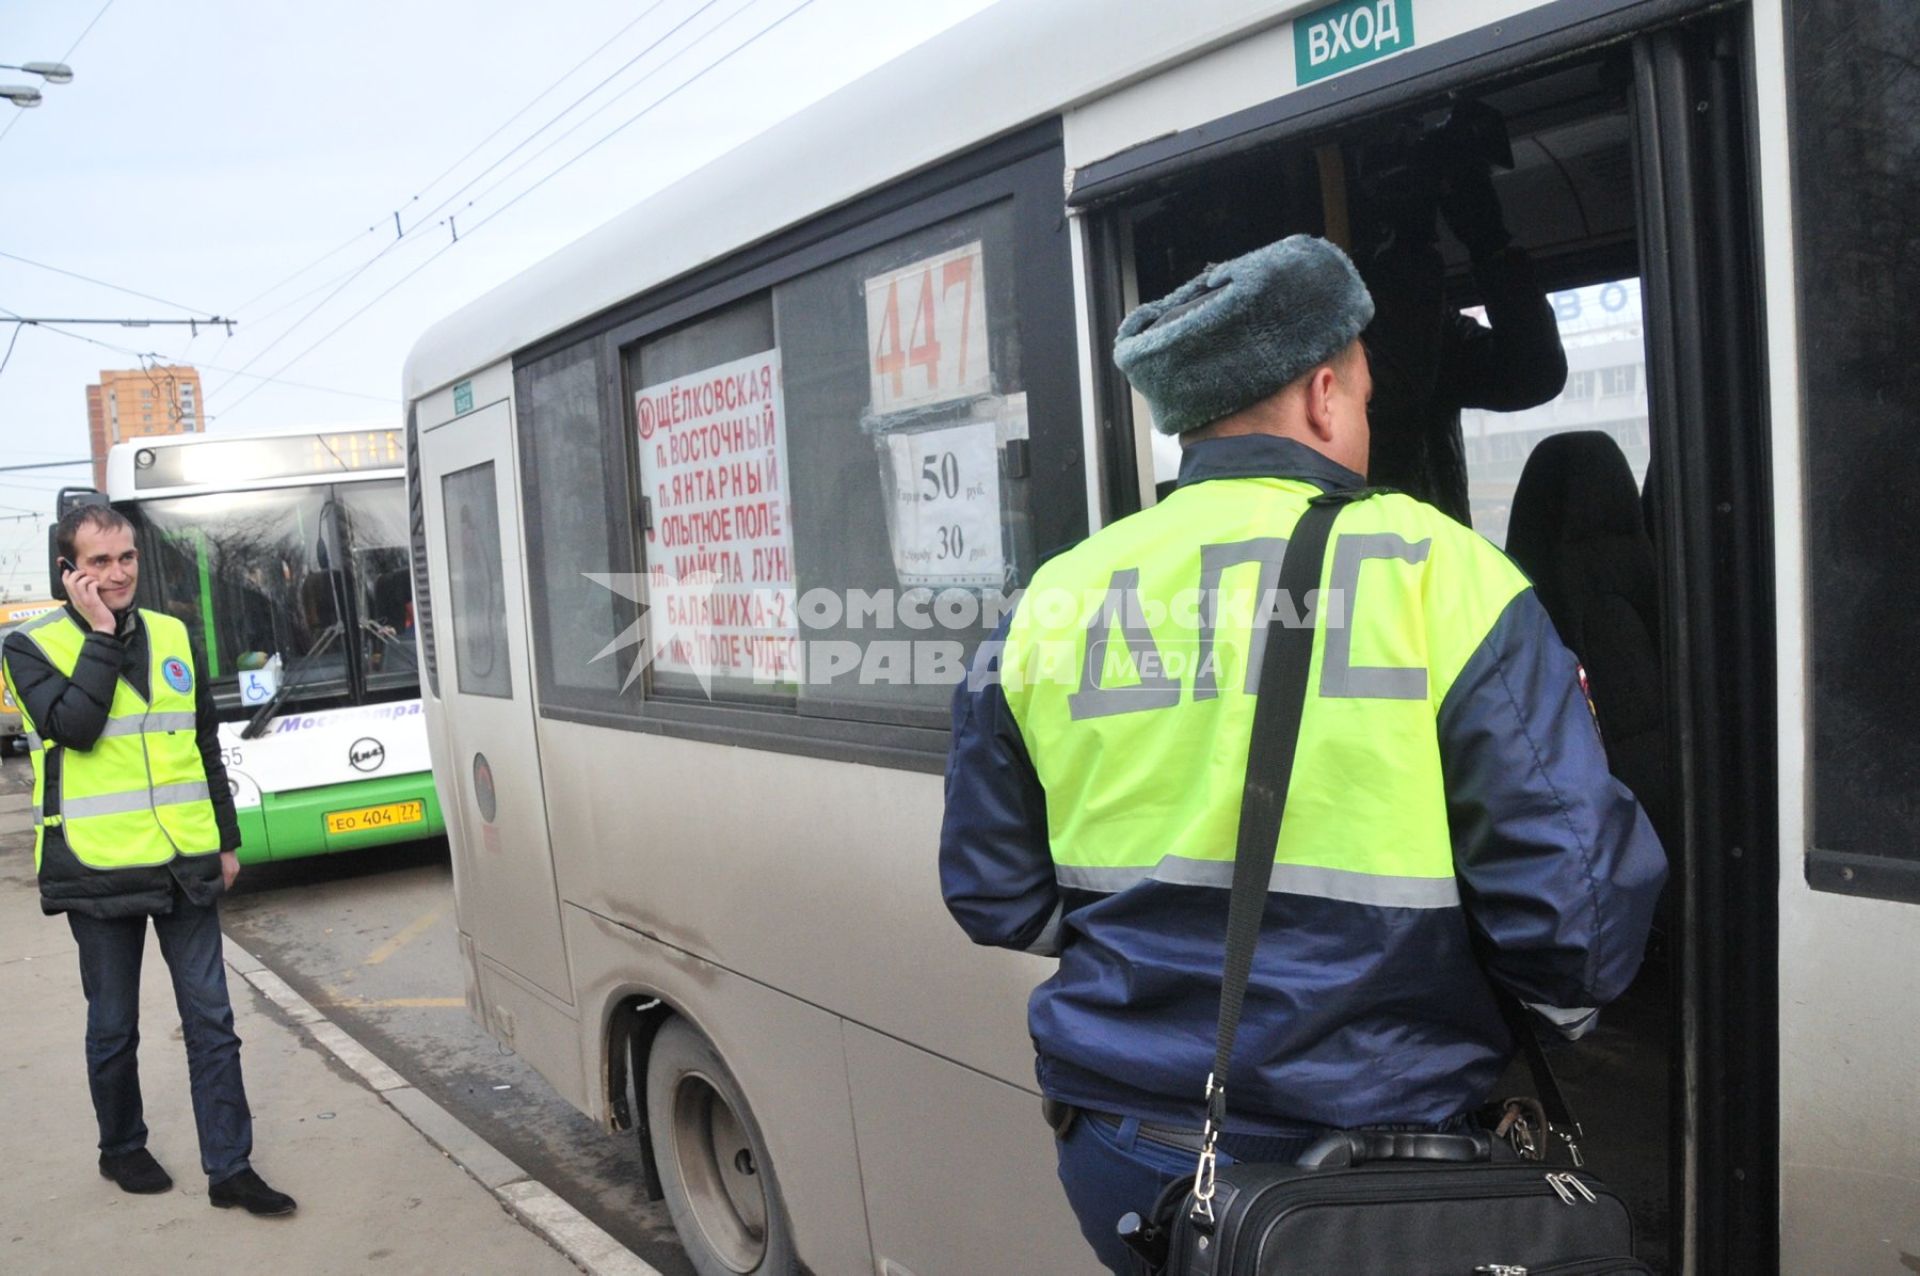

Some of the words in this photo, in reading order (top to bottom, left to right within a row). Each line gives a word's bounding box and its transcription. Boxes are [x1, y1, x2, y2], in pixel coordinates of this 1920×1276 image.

[1308, 0, 1400, 66] ВХОД
[875, 256, 974, 398] 447
[656, 365, 772, 432] ЩЁЛКОВСКАЯ
[670, 404, 776, 465] ВОСТОЧНЫЙ
[672, 449, 778, 506] ЯНТАРНЫЙ
[922, 451, 959, 501] 50
[662, 508, 732, 547] ОПЫТНОЕ
[735, 500, 781, 540] ПОЛЕ
[937, 525, 963, 560] 30
[675, 545, 744, 586] МАЙКЛА
[667, 592, 788, 628] БАЛАШИХА-2
[1067, 537, 1432, 721] ДПС
[363, 809, 391, 825] 404
[400, 804, 414, 817] 77
